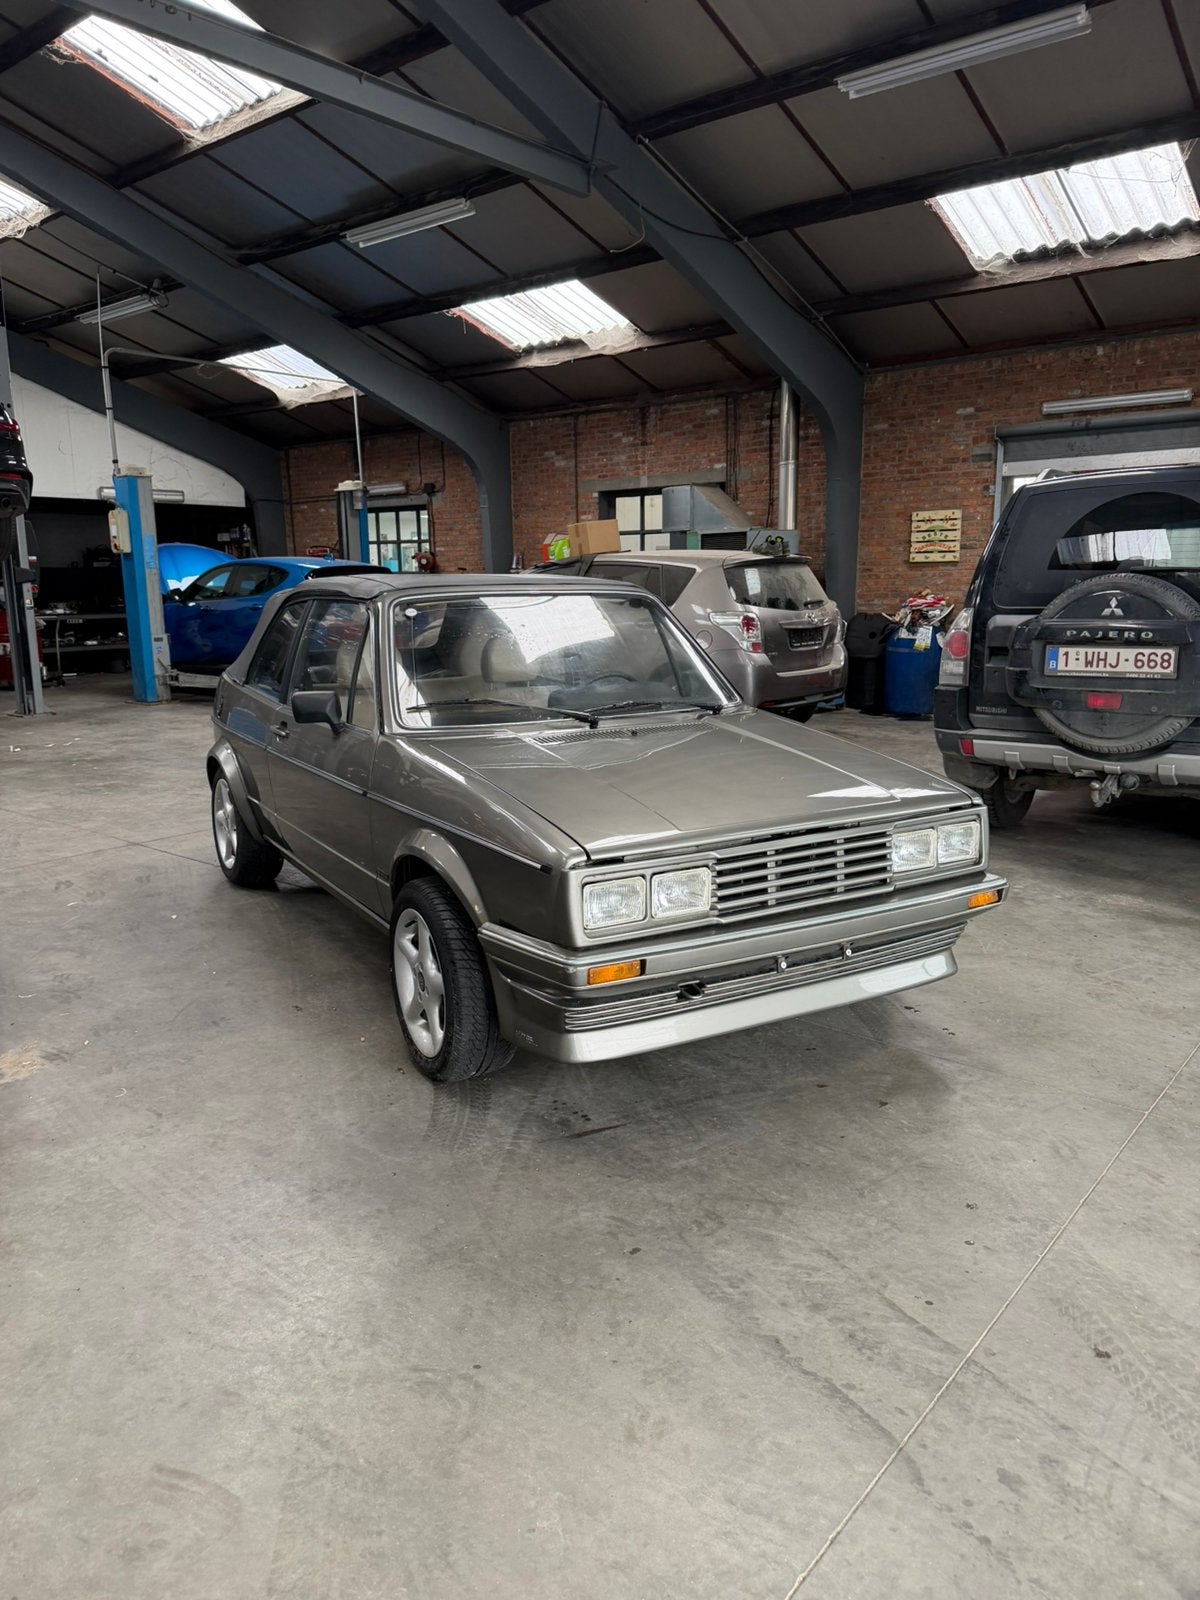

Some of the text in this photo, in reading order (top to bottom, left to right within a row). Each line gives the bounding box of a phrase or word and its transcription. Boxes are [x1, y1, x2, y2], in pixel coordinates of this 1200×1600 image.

[1066, 630, 1153, 639] PAJERO
[1049, 660, 1056, 668] B
[1062, 651, 1172, 669] 1-WHJ-668
